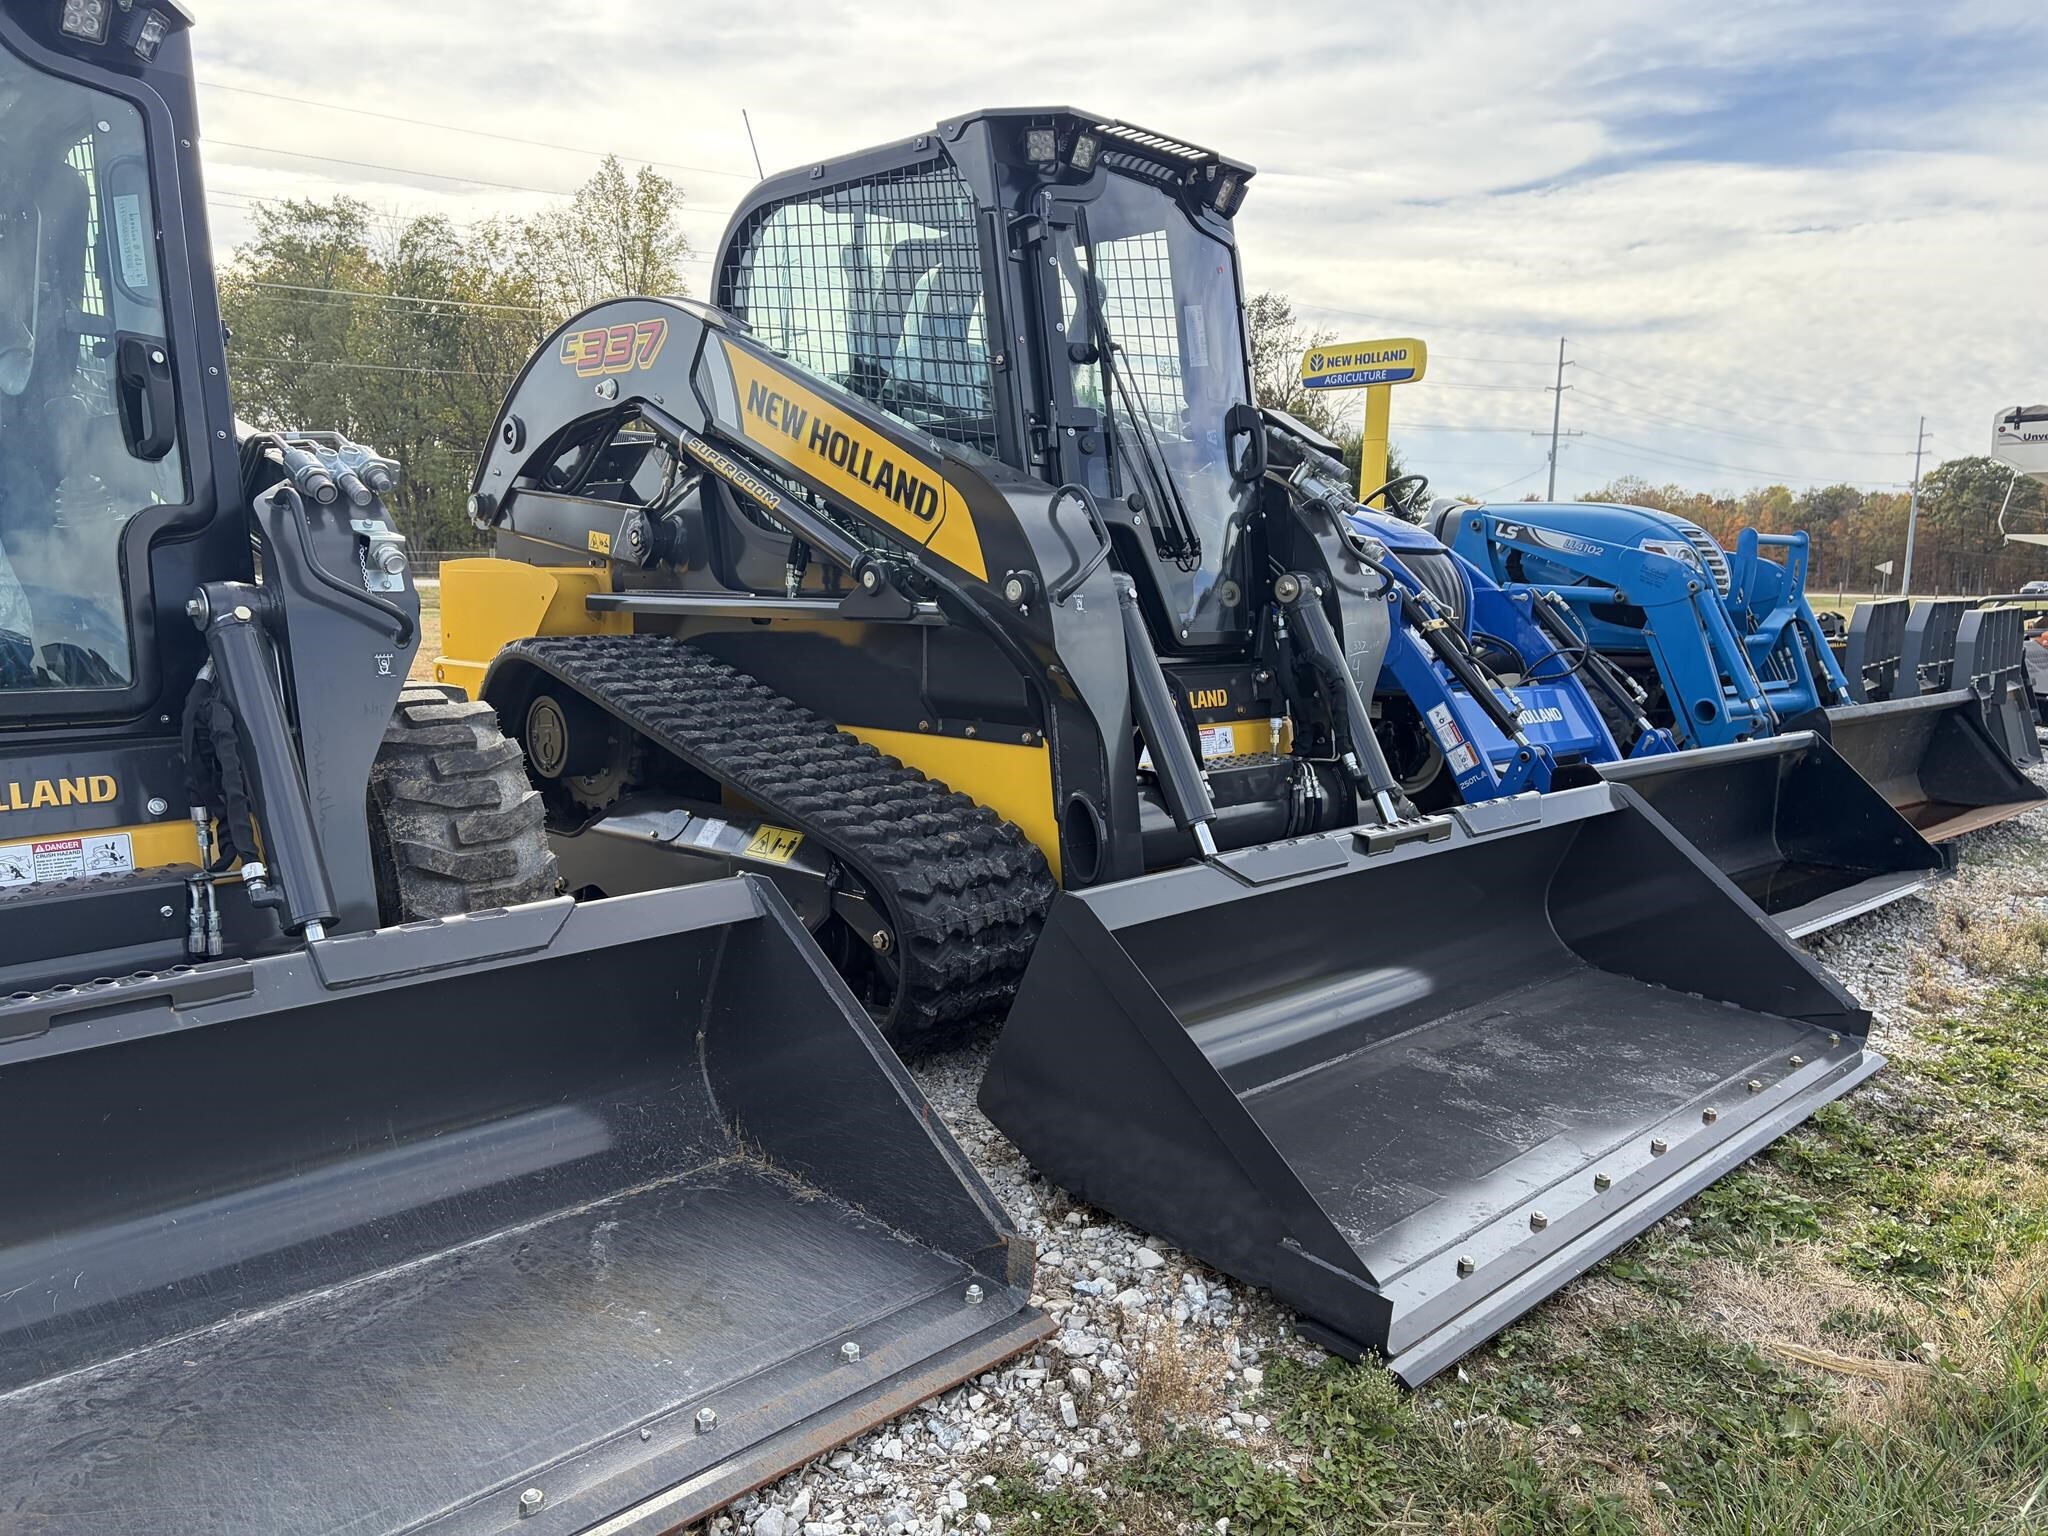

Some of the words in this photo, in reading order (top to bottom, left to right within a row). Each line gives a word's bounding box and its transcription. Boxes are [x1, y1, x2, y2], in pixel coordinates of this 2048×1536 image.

[1327, 355, 1352, 368] NEW
[1354, 349, 1407, 365] HOLLAND
[1324, 370, 1387, 385] AGRICULTURE
[746, 378, 807, 442] NEW
[808, 416, 940, 525] HOLLAND
[687, 437, 737, 480] SUPER
[732, 470, 781, 511] BOOM
[1495, 523, 1519, 539] LS
[1562, 538, 1604, 556] LL4102
[44, 841, 80, 852] DANGER
